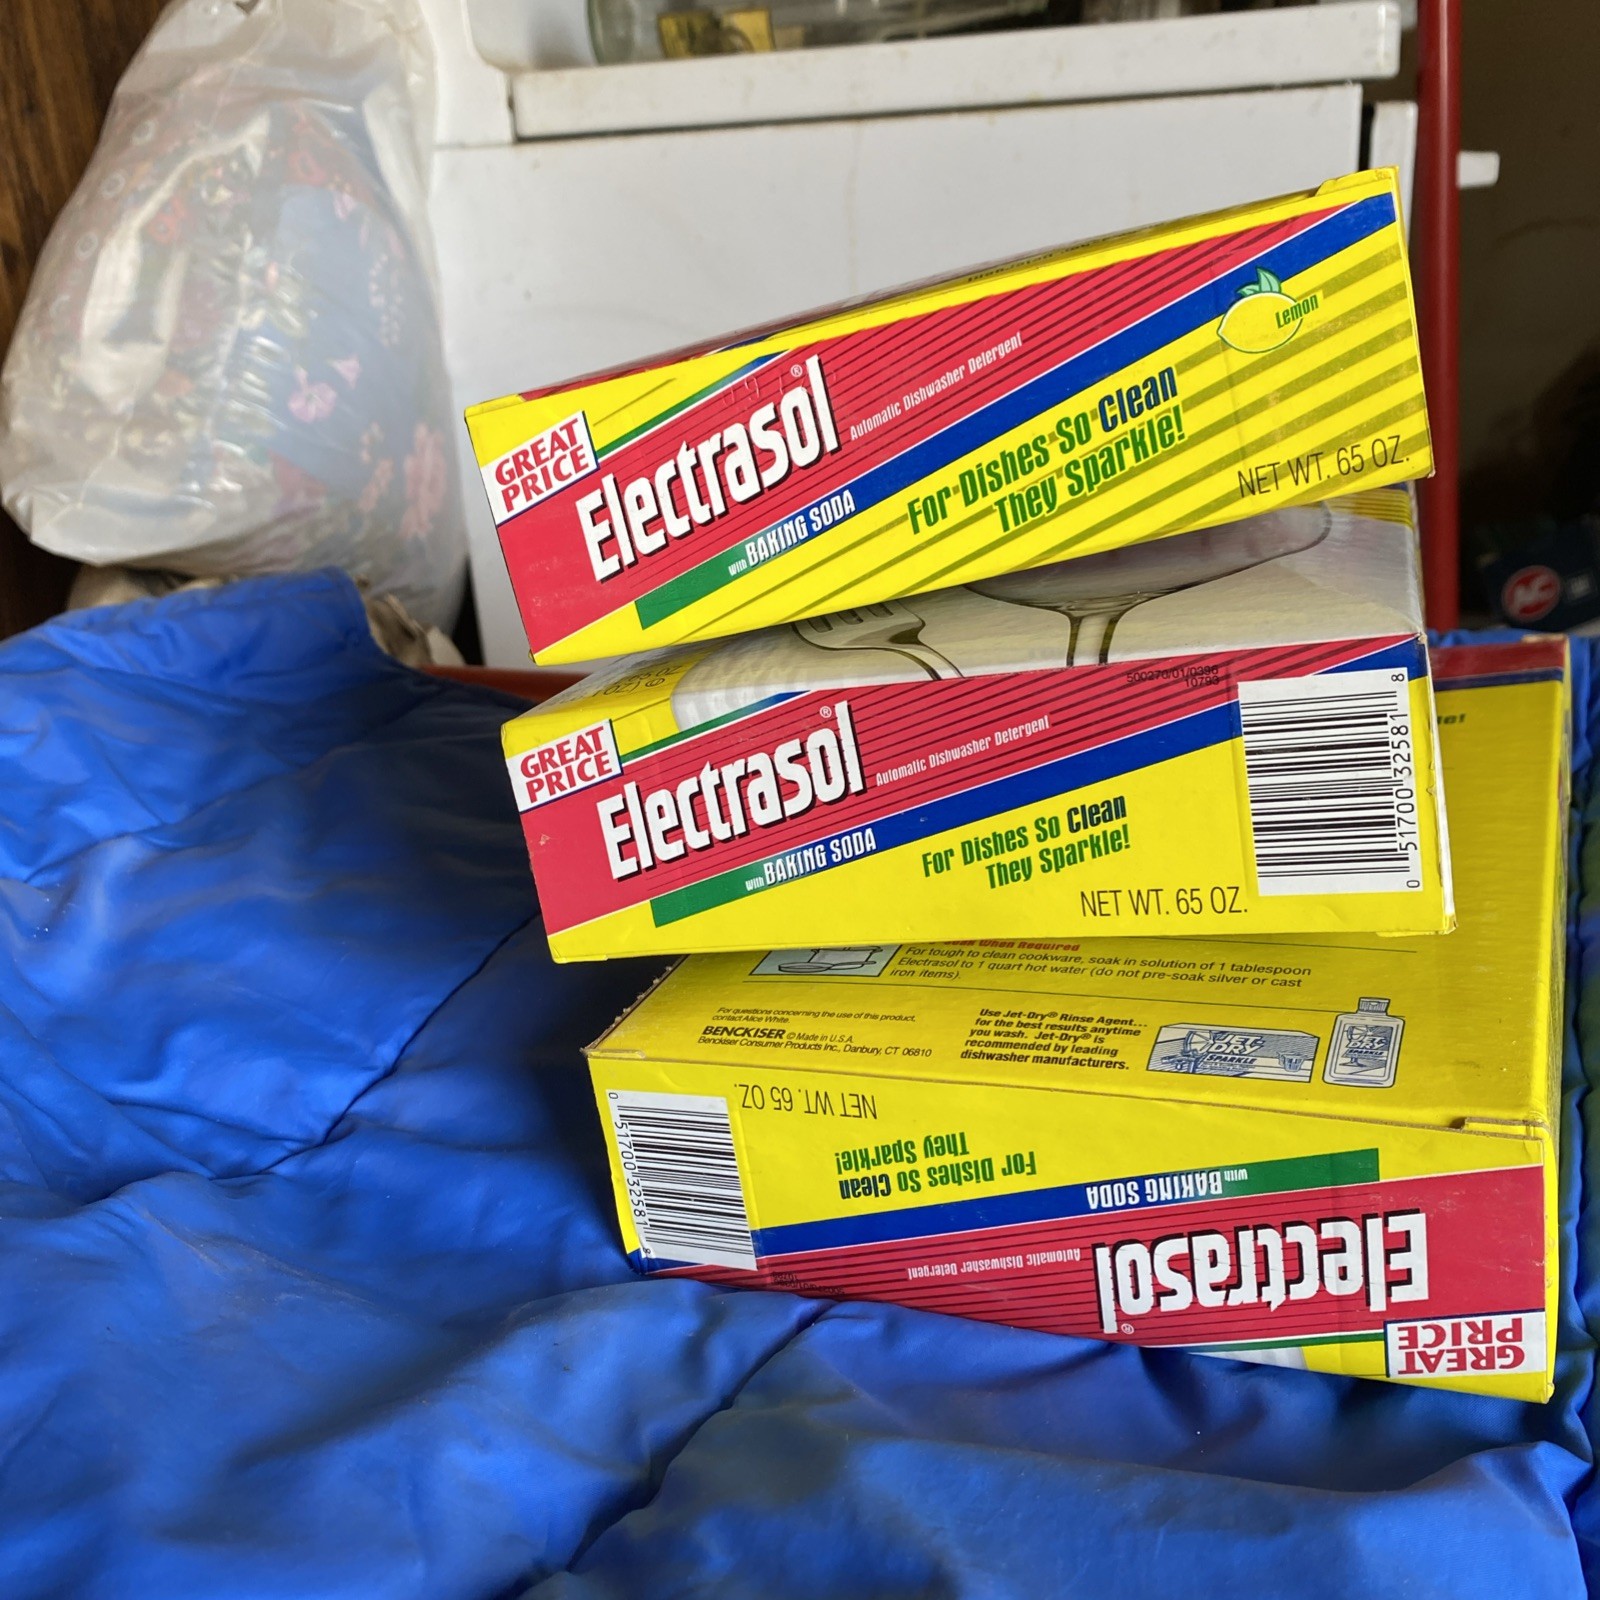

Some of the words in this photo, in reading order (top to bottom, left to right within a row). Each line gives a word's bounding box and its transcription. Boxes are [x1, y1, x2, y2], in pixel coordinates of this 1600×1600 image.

[1275, 294, 1319, 329] Lemon
[850, 402, 901, 441] Automatic
[903, 365, 965, 411] Dishwasher
[968, 331, 1022, 374] Detergent
[495, 418, 579, 485] GREAT
[908, 486, 951, 535] For
[958, 434, 1050, 507] Dishes
[1056, 411, 1092, 455] So
[1098, 366, 1178, 433] Clean
[501, 445, 589, 513] PRICE
[995, 476, 1057, 532] They
[1064, 404, 1186, 496] Sparkle!
[1237, 462, 1280, 498] NET
[1287, 452, 1330, 486] WT.
[1336, 444, 1365, 476] 65
[1371, 435, 1410, 468] OZ.
[745, 515, 807, 567] BAKING
[811, 489, 856, 533] SODA
[1391, 672, 1405, 682] 8
[520, 726, 604, 779] GREAT
[875, 760, 927, 786] Automatic
[929, 735, 991, 769] Dishwasher
[995, 714, 1050, 746] Detergent
[1390, 713, 1412, 778] 32581
[526, 755, 612, 803] PRICE
[1394, 787, 1418, 851] 51700
[922, 848, 954, 878] For
[960, 825, 1029, 865] Dishes
[1034, 815, 1061, 843] So
[1066, 795, 1127, 834] Clean
[764, 845, 827, 886] BAKING
[831, 827, 877, 864] SODA
[985, 856, 1033, 889] They
[1039, 823, 1131, 874] Sparkle!
[1406, 879, 1420, 889] 0
[1080, 889, 1122, 917] NET
[1129, 888, 1170, 916] WT.
[1176, 888, 1203, 914] 65
[1209, 886, 1248, 914] OZ.
[979, 939, 1015, 948] When
[1017, 941, 1081, 951] Required
[889, 968, 915, 977] iron
[918, 969, 961, 980] items).
[898, 957, 959, 968] Electrasol
[960, 960, 974, 968] to
[978, 960, 984, 969] 1
[987, 961, 1023, 972] quart
[1024, 962, 1047, 972] hot
[1050, 965, 1088, 975] water
[1090, 966, 1113, 977] (do
[1116, 969, 1140, 978] not
[1142, 970, 1205, 982] pre-soak
[1208, 973, 1248, 984] silver
[1251, 976, 1268, 986] or
[1270, 978, 1302, 987] cast
[905, 947, 924, 955] For
[928, 948, 965, 960] tough
[966, 949, 980, 958] to
[982, 949, 1016, 960] clean
[1018, 951, 1084, 964] cookware,
[1088, 956, 1122, 965] soak
[1123, 956, 1136, 966] in
[1140, 958, 1196, 969] solution
[1200, 961, 1215, 970] of
[1219, 962, 1226, 971] 1
[1230, 963, 1311, 976] tablespoon
[732, 1008, 772, 1017] questions
[772, 1009, 821, 1019] concerning
[821, 1010, 836, 1018] the
[743, 1015, 763, 1023] Alice
[975, 1018, 991, 1026] for
[994, 1019, 1014, 1027] the
[1016, 1020, 1042, 1029] best
[1045, 1023, 1088, 1033] results
[1090, 1026, 1141, 1037] anytime
[979, 1008, 1001, 1017] Use
[1059, 1013, 1095, 1023] Rinse
[697, 1036, 740, 1046] Benckiser
[741, 1039, 784, 1049] Consumer
[784, 1041, 822, 1051] Products
[884, 1046, 899, 1055] CT
[902, 1047, 932, 1058] 06810
[701, 1025, 786, 1039] BENCKISER
[796, 1033, 818, 1041] Made
[819, 1034, 828, 1042] in
[969, 1028, 991, 1038] you
[993, 1030, 1028, 1039] wash.
[1093, 1035, 1105, 1044] is
[960, 1050, 1031, 1063] dishwasher
[1031, 1055, 1130, 1070] manufacturers.
[965, 1039, 1051, 1052] recommended
[1053, 1042, 1068, 1054] by
[1070, 1044, 1119, 1057] leading
[1206, 1054, 1257, 1064] SPARKLE
[1207, 1042, 1261, 1055] DRY
[733, 1083, 764, 1110] OZ.
[770, 1086, 793, 1112] 65
[798, 1088, 834, 1116] WT.
[839, 1092, 877, 1120] NET
[835, 1140, 917, 1175] Sparkle!
[924, 1131, 970, 1159] They
[608, 1092, 619, 1100] 0
[614, 1120, 637, 1172] 51700
[626, 1178, 649, 1228] 32581
[927, 1157, 995, 1189] Dishes
[1002, 1151, 1036, 1177] For
[840, 1172, 892, 1200] Clean
[899, 1168, 922, 1193] So
[1147, 1171, 1223, 1202] BAKING
[1086, 1184, 1140, 1210] SODA
[961, 1255, 1023, 1273] Dishwasher
[1027, 1248, 1081, 1266] Automatic
[907, 1263, 957, 1280] Detergent
[1398, 1318, 1524, 1349] PRICE
[1397, 1345, 1525, 1376] GREAT
